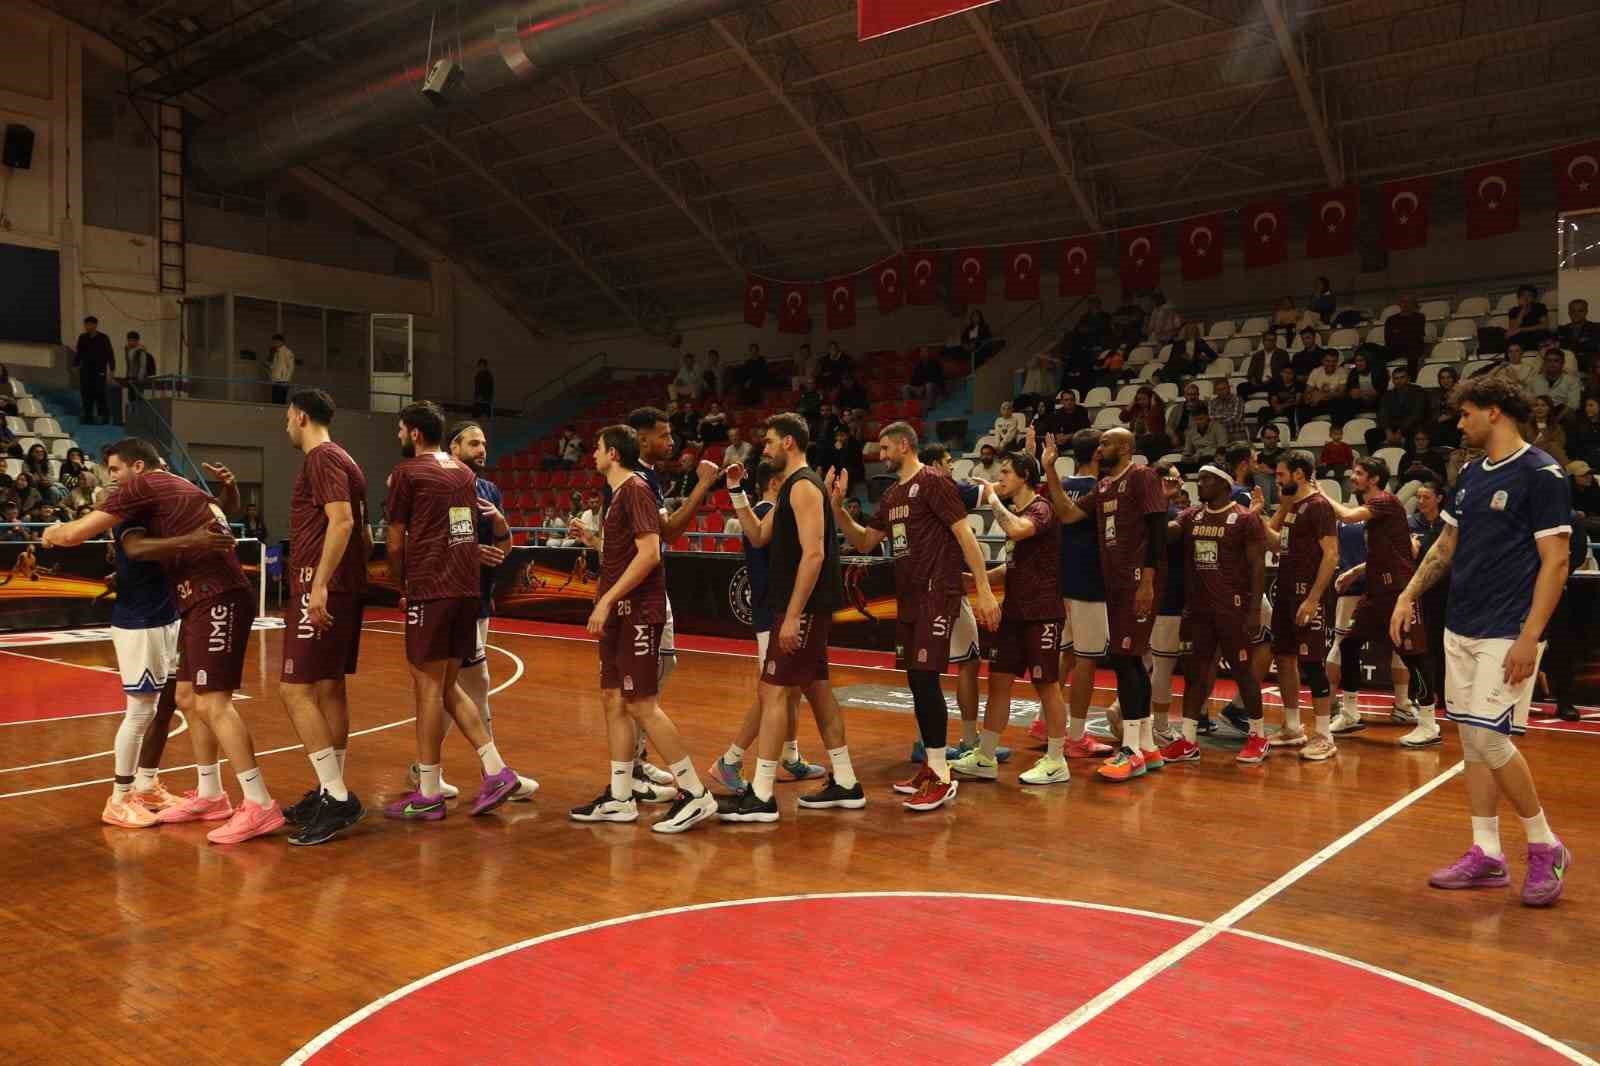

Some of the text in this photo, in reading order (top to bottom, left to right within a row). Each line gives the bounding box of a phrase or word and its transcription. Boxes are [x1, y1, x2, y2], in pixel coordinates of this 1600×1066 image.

[299, 567, 312, 583] 18
[177, 580, 192, 599] 32
[1295, 582, 1307, 595] 15
[617, 600, 632, 616] 26
[208, 604, 228, 652] UMG
